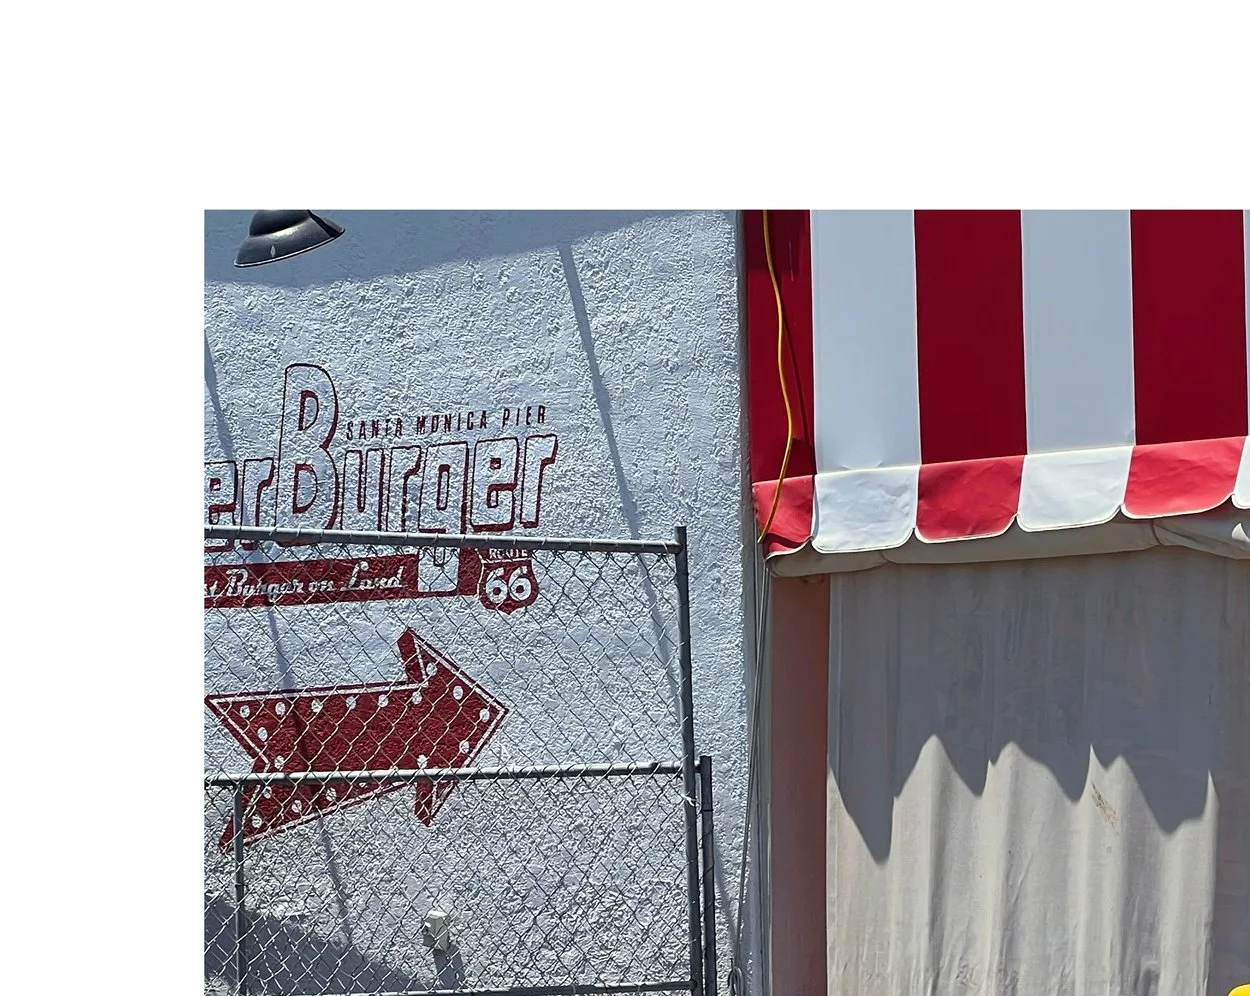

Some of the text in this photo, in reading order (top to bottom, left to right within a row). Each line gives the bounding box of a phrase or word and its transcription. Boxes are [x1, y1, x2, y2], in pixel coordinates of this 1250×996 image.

[346, 404, 546, 441] SANTA MONICA PIER
[308, 579, 335, 592] on
[340, 560, 408, 592] Land
[485, 565, 532, 604] 66
